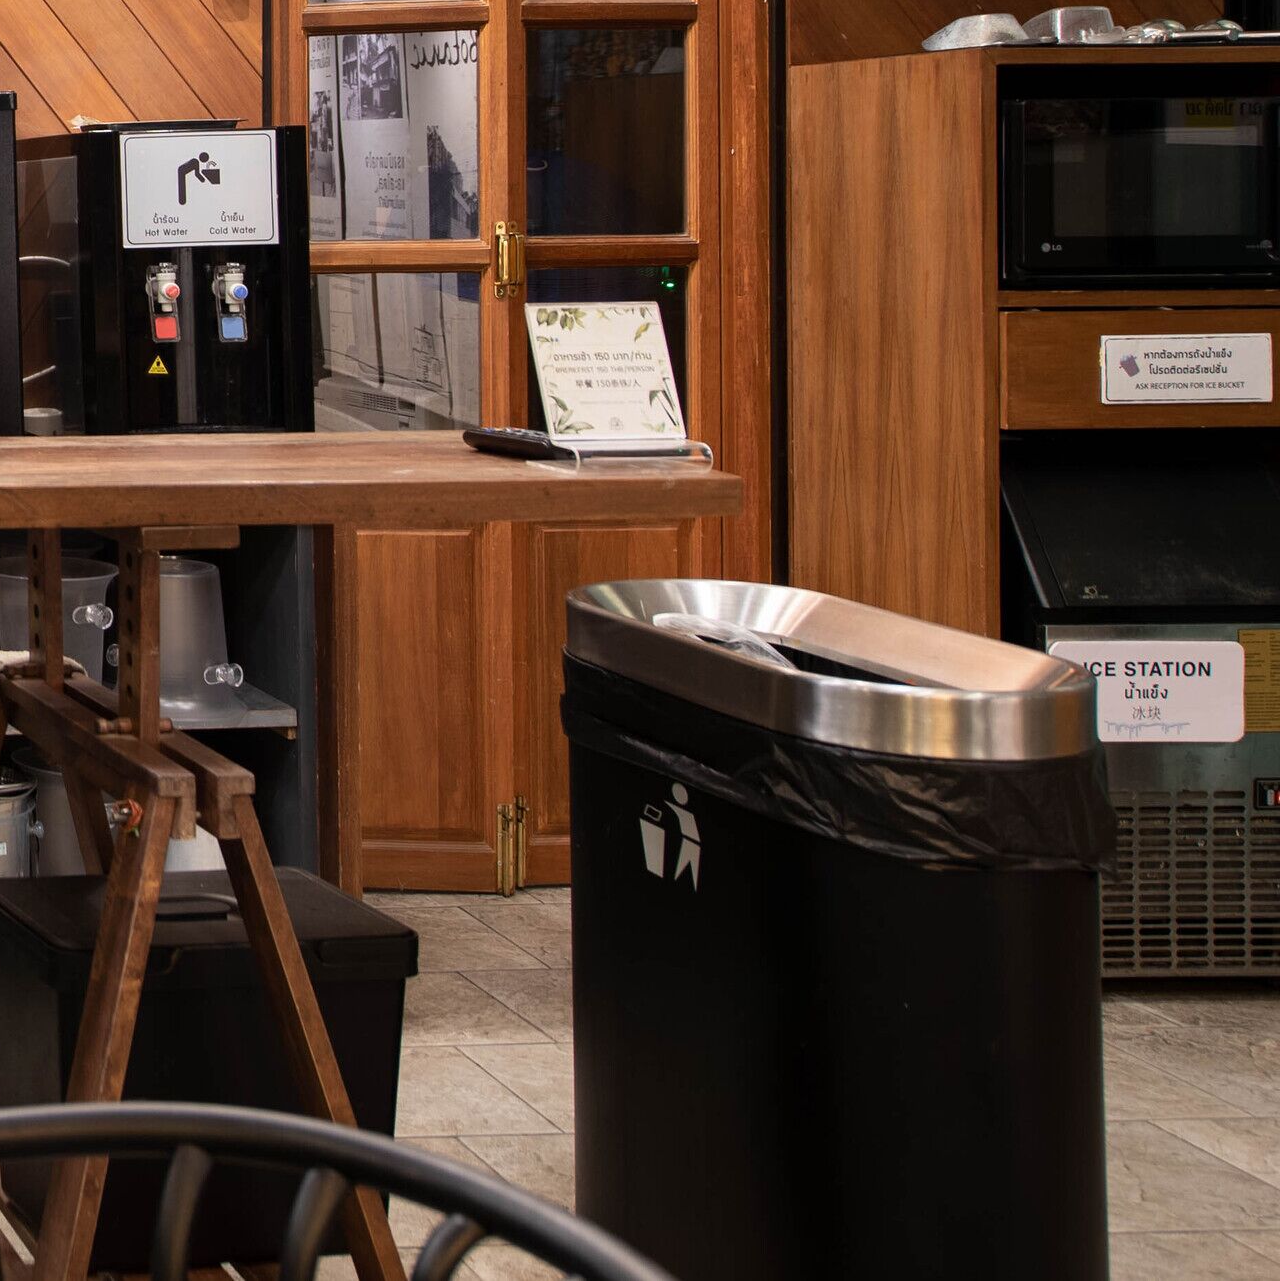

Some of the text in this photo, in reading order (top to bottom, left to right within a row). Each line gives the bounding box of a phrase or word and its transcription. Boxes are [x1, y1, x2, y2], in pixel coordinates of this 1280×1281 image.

[145, 228, 188, 237] Hot Water
[210, 226, 257, 235] Cold Water
[594, 352, 610, 361] 150
[1135, 382, 1149, 390] ASK
[1150, 382, 1189, 390] RECEPTION
[1124, 662, 1212, 677] STATION
[1124, 682, 1168, 700] น้ำแข็ง
[1132, 706, 1162, 721] 冰块
